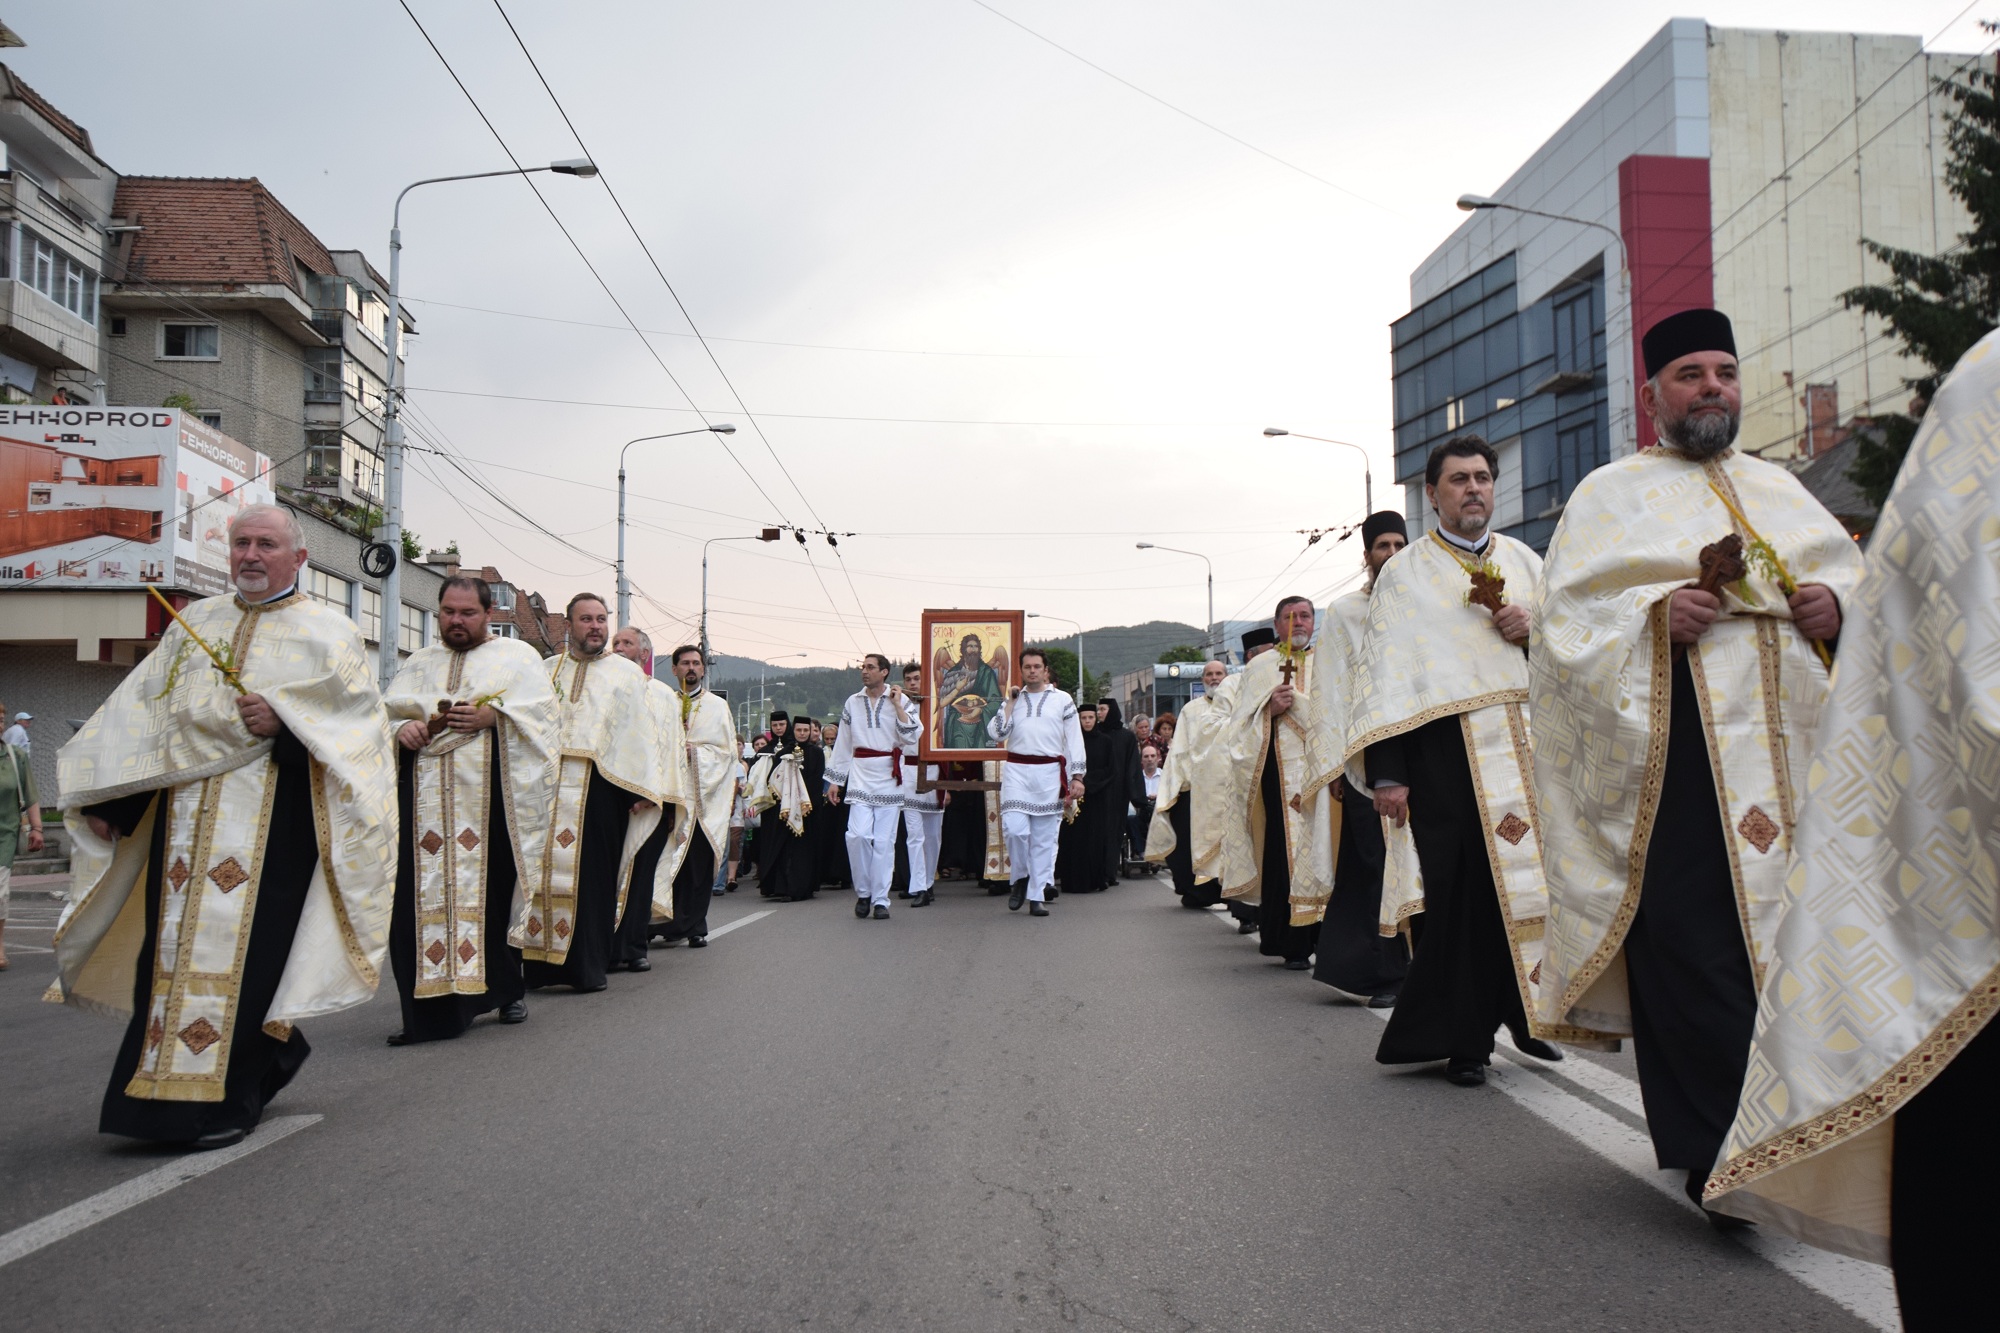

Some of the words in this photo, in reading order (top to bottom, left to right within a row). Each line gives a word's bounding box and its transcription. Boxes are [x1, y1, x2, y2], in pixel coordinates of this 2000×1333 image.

[180, 429, 247, 473] TEHNOPROD
[0, 566, 24, 579] ila
[1182, 667, 1203, 676] ALP
